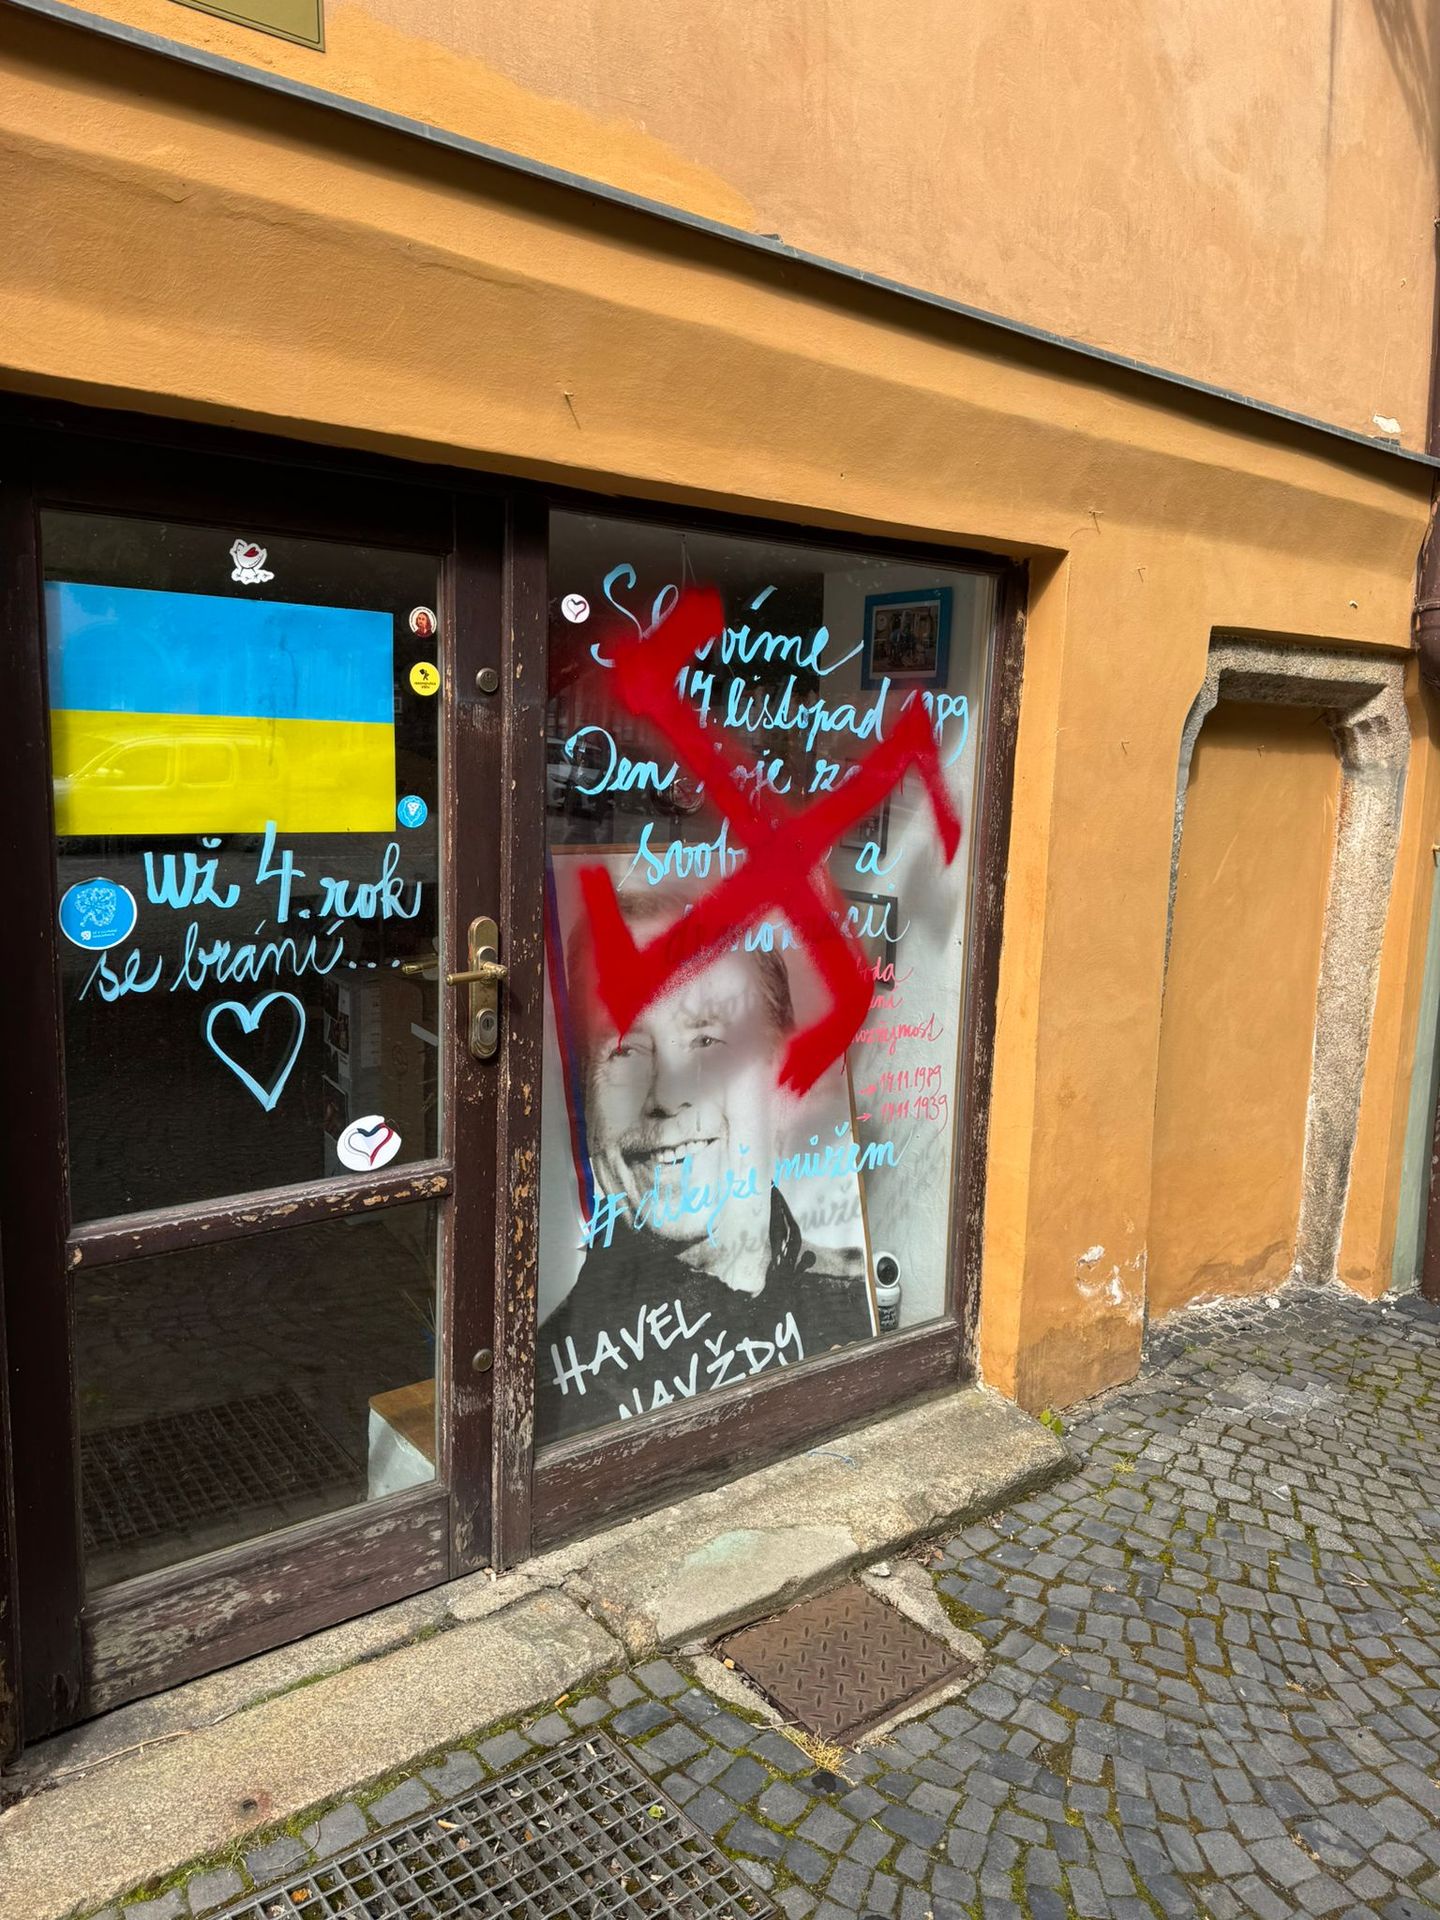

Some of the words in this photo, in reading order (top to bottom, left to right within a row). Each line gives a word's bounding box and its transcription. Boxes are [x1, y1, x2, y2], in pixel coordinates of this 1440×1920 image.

[723, 674, 891, 752] listopad
[564, 725, 680, 796] Den
[255, 819, 312, 923] 4.
[318, 842, 422, 919] rok
[855, 841, 903, 877] a
[79, 947, 163, 1002] se
[552, 1299, 712, 1396] HAVEL
[618, 1311, 805, 1421] NAVŽDY
